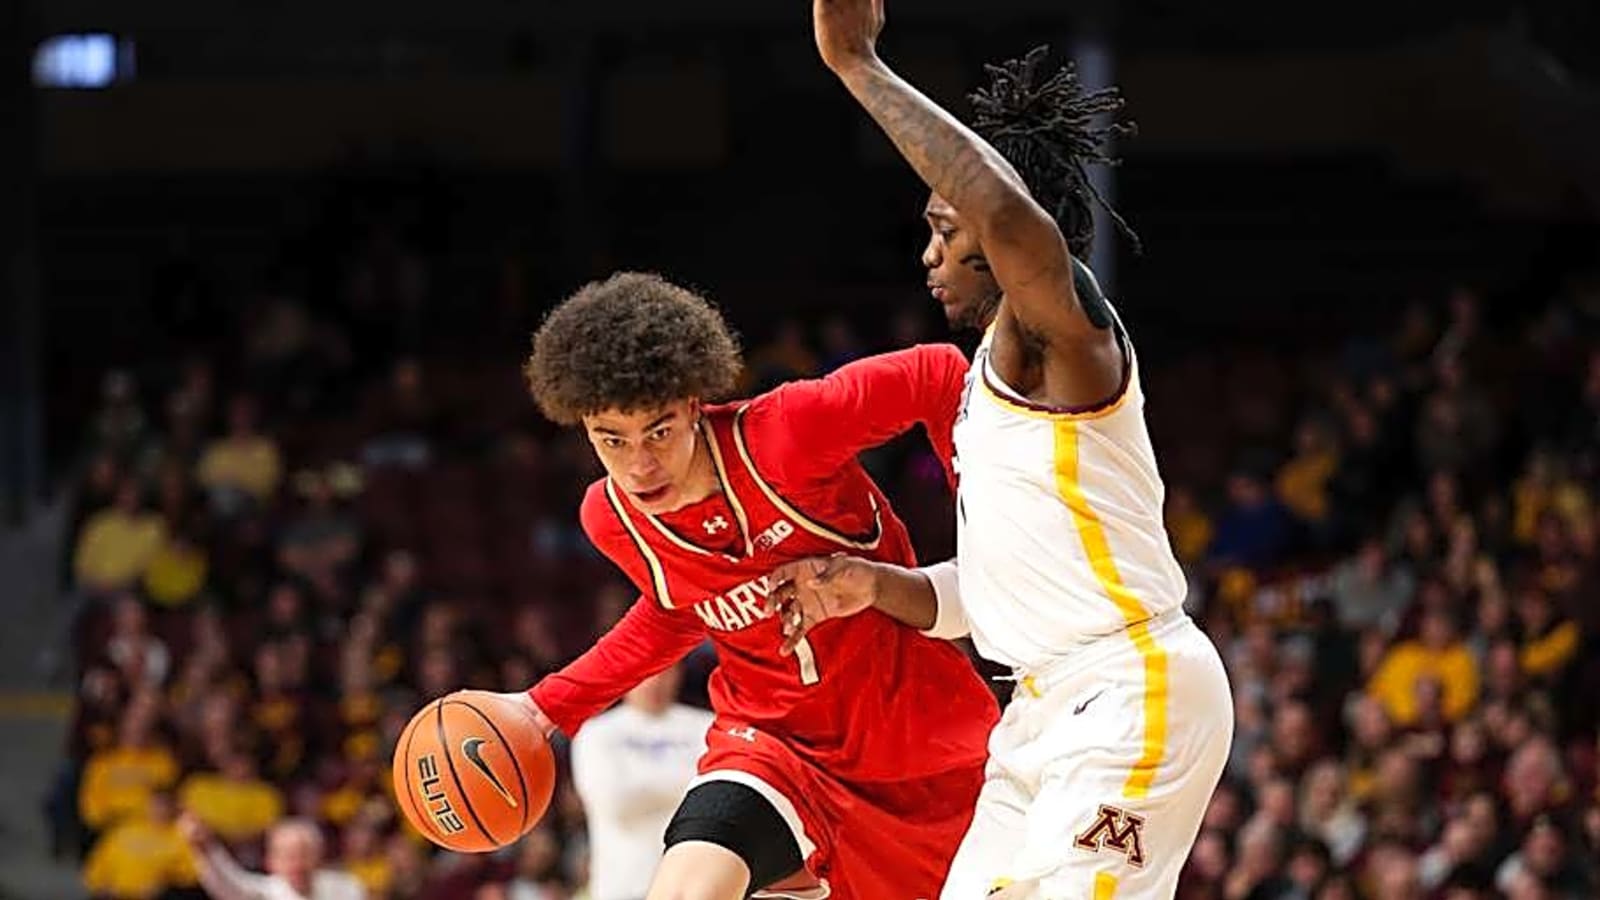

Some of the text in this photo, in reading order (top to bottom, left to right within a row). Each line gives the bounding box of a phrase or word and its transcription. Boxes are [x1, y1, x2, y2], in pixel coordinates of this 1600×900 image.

[693, 575, 773, 631] MARY
[795, 635, 819, 685] 1
[417, 754, 465, 834] ELITE
[1073, 804, 1145, 868] M
